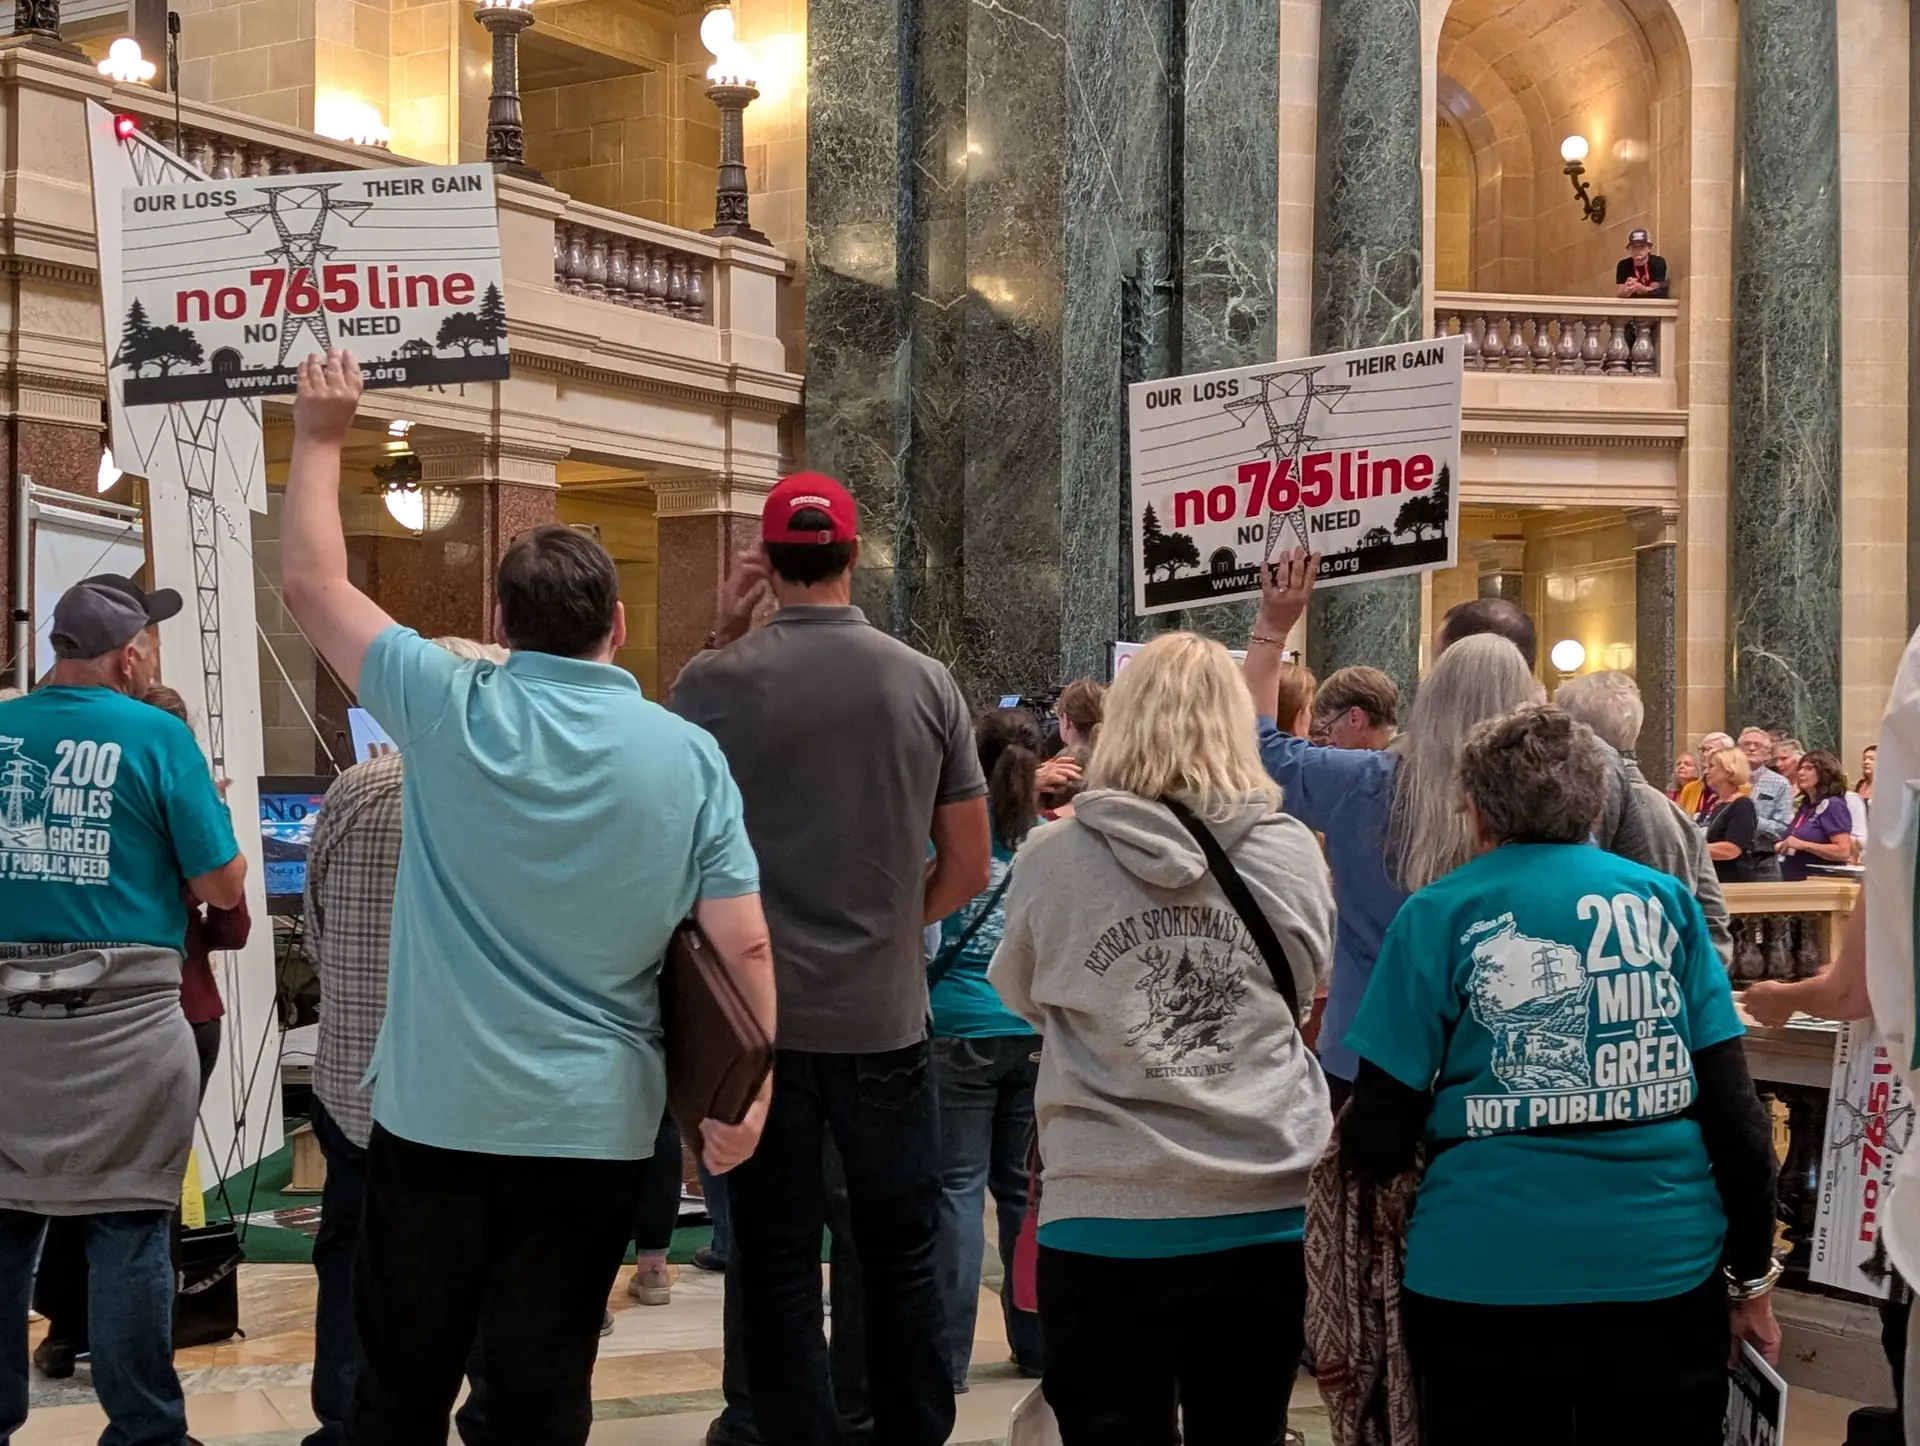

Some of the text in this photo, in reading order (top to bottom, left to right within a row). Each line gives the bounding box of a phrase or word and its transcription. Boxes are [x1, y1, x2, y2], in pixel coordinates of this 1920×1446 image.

[133, 190, 237, 213] OUR LOSS
[363, 175, 482, 198] THEIR GAIN
[244, 315, 400, 344] NO NEED
[1346, 347, 1444, 379] THEIR GAIN
[1146, 379, 1239, 409] OUR LOSS
[1238, 509, 1361, 545] NO NEED
[51, 739, 122, 788] 200
[51, 787, 113, 818] MILES
[71, 816, 85, 827] OF
[49, 825, 110, 855] GREED
[11, 853, 67, 874] PUBLIC
[69, 857, 110, 878] NEED
[1084, 916, 1143, 977] RETREAT
[1142, 906, 1240, 943] SPORTSMANS
[1576, 893, 1680, 972] 200
[1596, 971, 1682, 1024] MILES
[1635, 1020, 1656, 1039] OF
[1595, 1034, 1692, 1087] GREED
[1466, 1079, 1691, 1128] NOT PUBLIC NEED
[1816, 1169, 1834, 1262] OUR LOSS
